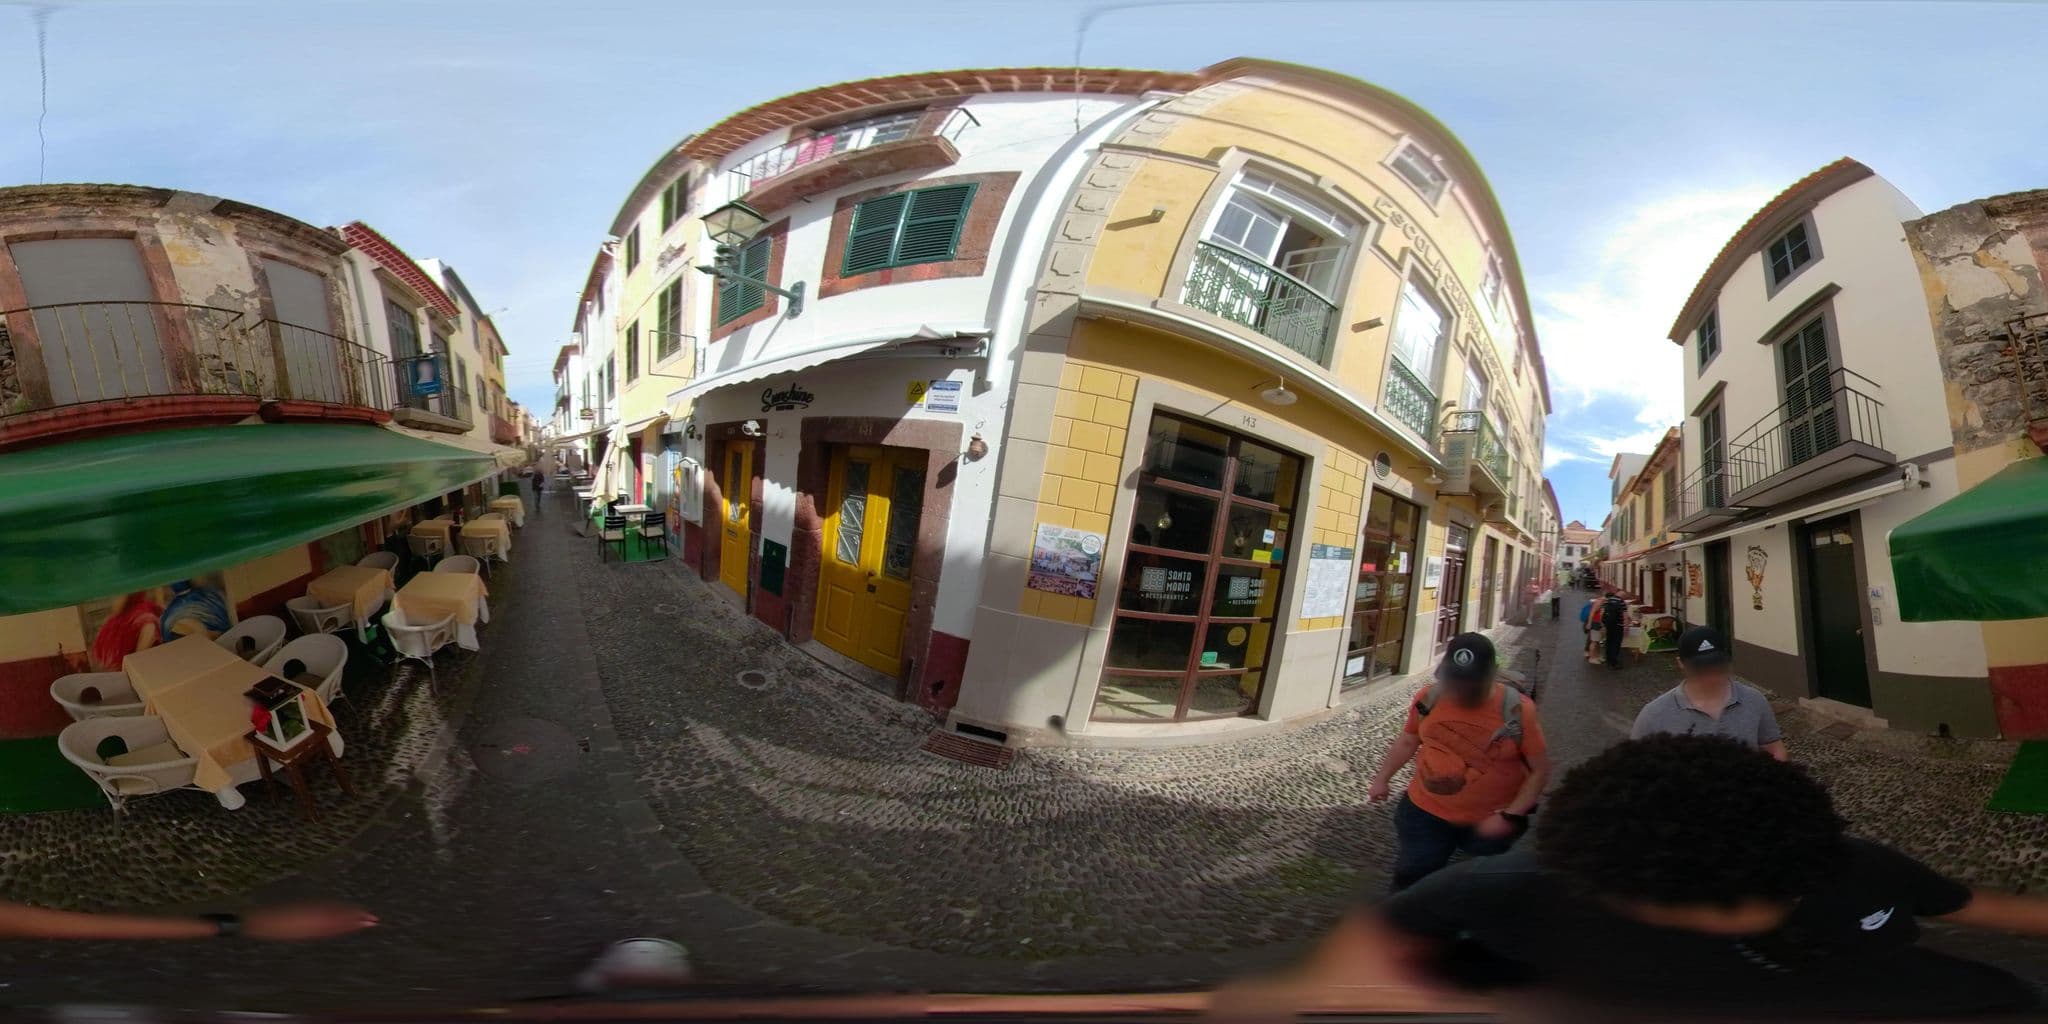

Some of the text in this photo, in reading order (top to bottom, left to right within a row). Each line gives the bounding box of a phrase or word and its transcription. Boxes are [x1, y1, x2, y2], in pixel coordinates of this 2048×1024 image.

[1373, 195, 1442, 279] ESCOLA
[761, 382, 815, 412] Sunshine
[1242, 415, 1257, 428] 143
[1167, 570, 1192, 582] SANTA
[1166, 582, 1191, 592] MARIA
[1145, 593, 1184, 601] RESTAURANTE
